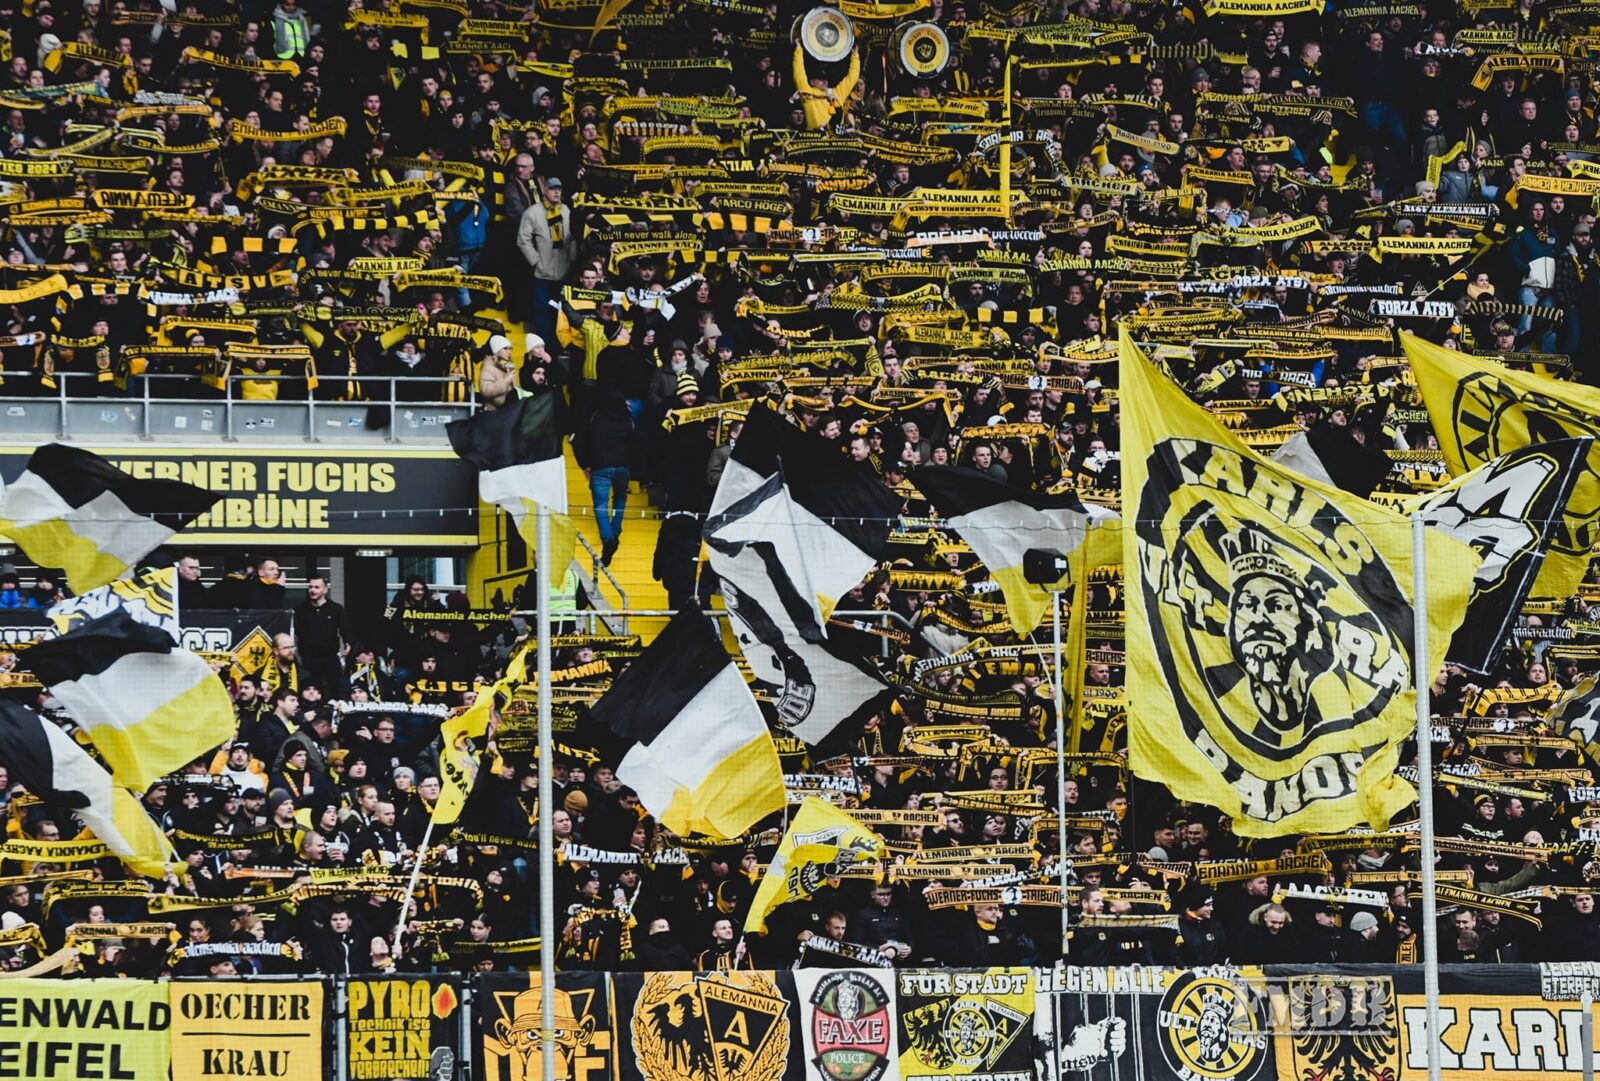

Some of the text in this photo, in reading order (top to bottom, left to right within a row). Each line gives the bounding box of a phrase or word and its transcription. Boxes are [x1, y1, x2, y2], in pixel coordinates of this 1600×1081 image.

[729, 2, 764, 15] BAYERN
[1219, 0, 1311, 11] ALEMANNIA AACHEN
[1490, 56, 1560, 69] ALEMANNIA
[949, 102, 963, 110] Mit
[27, 164, 57, 173] 2024
[705, 184, 782, 193] ALEMANNIA AACHEN
[922, 191, 1020, 204] ALEMANNIA AACEN
[909, 204, 944, 213] AACHEN
[1281, 218, 1317, 236] AACHEN
[624, 231, 649, 241] never
[651, 230, 672, 240] walk
[1382, 239, 1473, 250] ALEMANNIA AACHEN
[1039, 257, 1130, 272] ALEMANNIA AACHEN
[408, 274, 496, 288] ALEMANNIA AACHEN
[1378, 301, 1421, 316] FORZA
[915, 327, 946, 340] ALEMANNIA
[950, 328, 973, 341] AACHEN
[267, 461, 396, 493] FUCHS
[1168, 438, 1377, 570] KARLS
[402, 610, 464, 621] Alemannia
[1004, 794, 1032, 804] 2024
[903, 812, 938, 823] AACHEN
[208, 841, 244, 850] Aachen
[565, 843, 638, 864] ALEMANNIA
[895, 867, 1011, 877] ALEMANNIA AACHEN
[930, 890, 968, 904] WERNER
[970, 889, 999, 901] FUCHS
[1120, 891, 1162, 900] AACHEN
[1435, 887, 1512, 908] ALEMANNIA AACHEN
[185, 942, 281, 958] alemannia aachen
[900, 969, 1028, 996] FÜR STADT
[1036, 966, 1166, 993] GEGEN ALLE
[347, 980, 432, 1019] PYRO
[705, 984, 779, 1014] ALEMANNIA
[0, 997, 171, 1032] ENWALD
[180, 993, 311, 1021] OECHER
[724, 1010, 750, 1046] A
[1160, 1010, 1196, 1032] ULT
[818, 1019, 884, 1045] FAXE
[349, 1031, 431, 1061] KEIN
[0, 1041, 136, 1080] EIFEL
[202, 1048, 290, 1077] KRAU
[829, 1053, 865, 1065] POLICE
